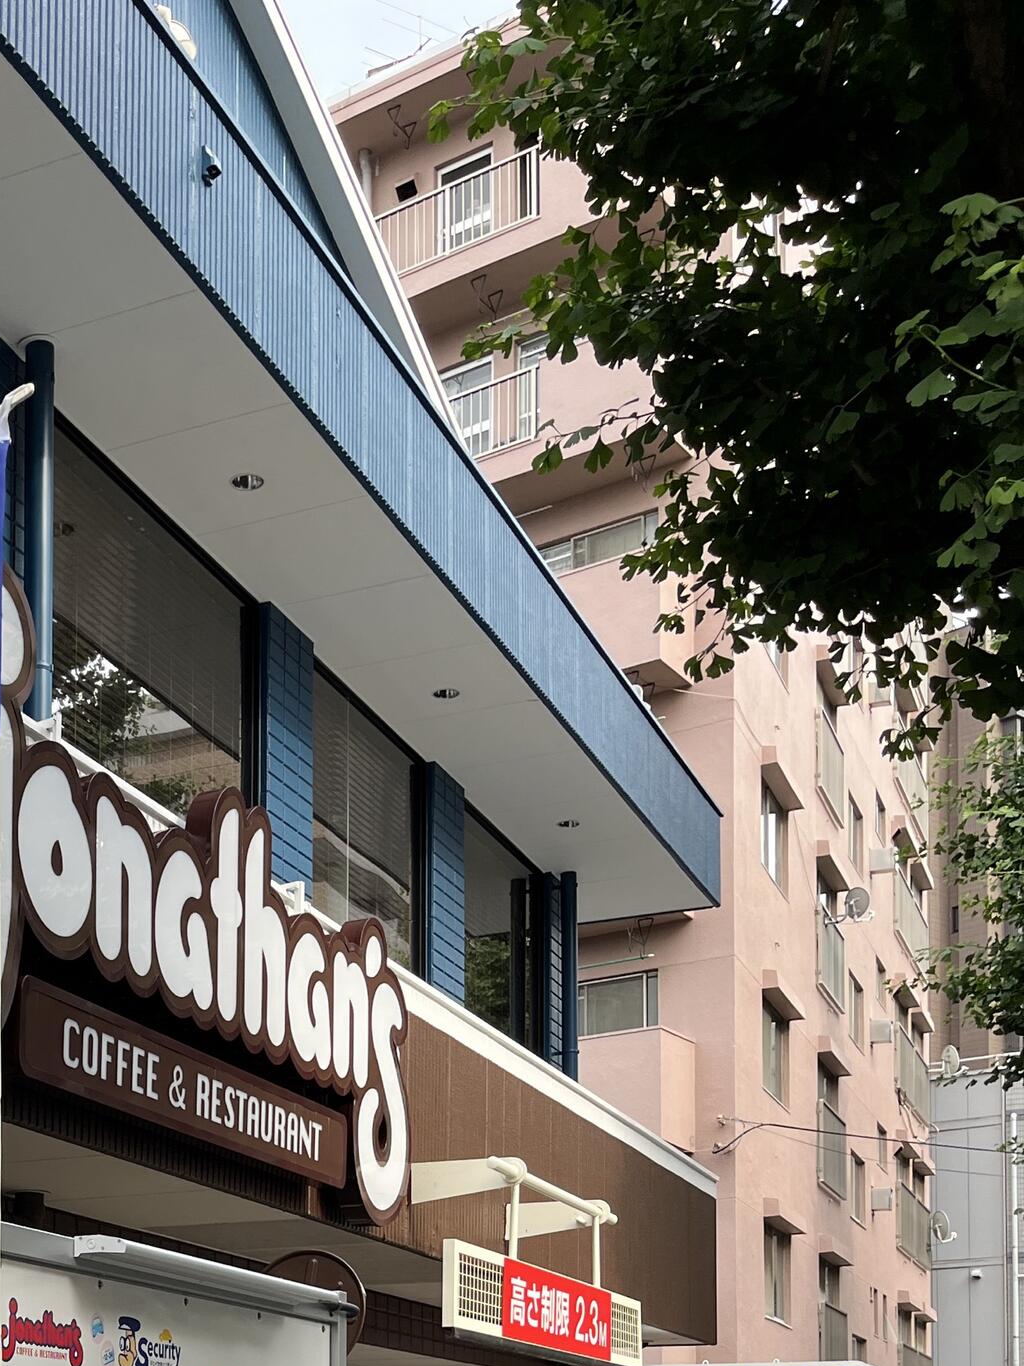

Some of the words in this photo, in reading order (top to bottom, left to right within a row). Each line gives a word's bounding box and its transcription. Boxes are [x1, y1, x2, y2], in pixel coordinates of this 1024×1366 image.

[62, 1017, 160, 1101] COFFEE
[168, 1064, 187, 1112] &
[195, 1073, 323, 1162] RESTAURANT
[510, 1276, 570, 1338] 高さ制限
